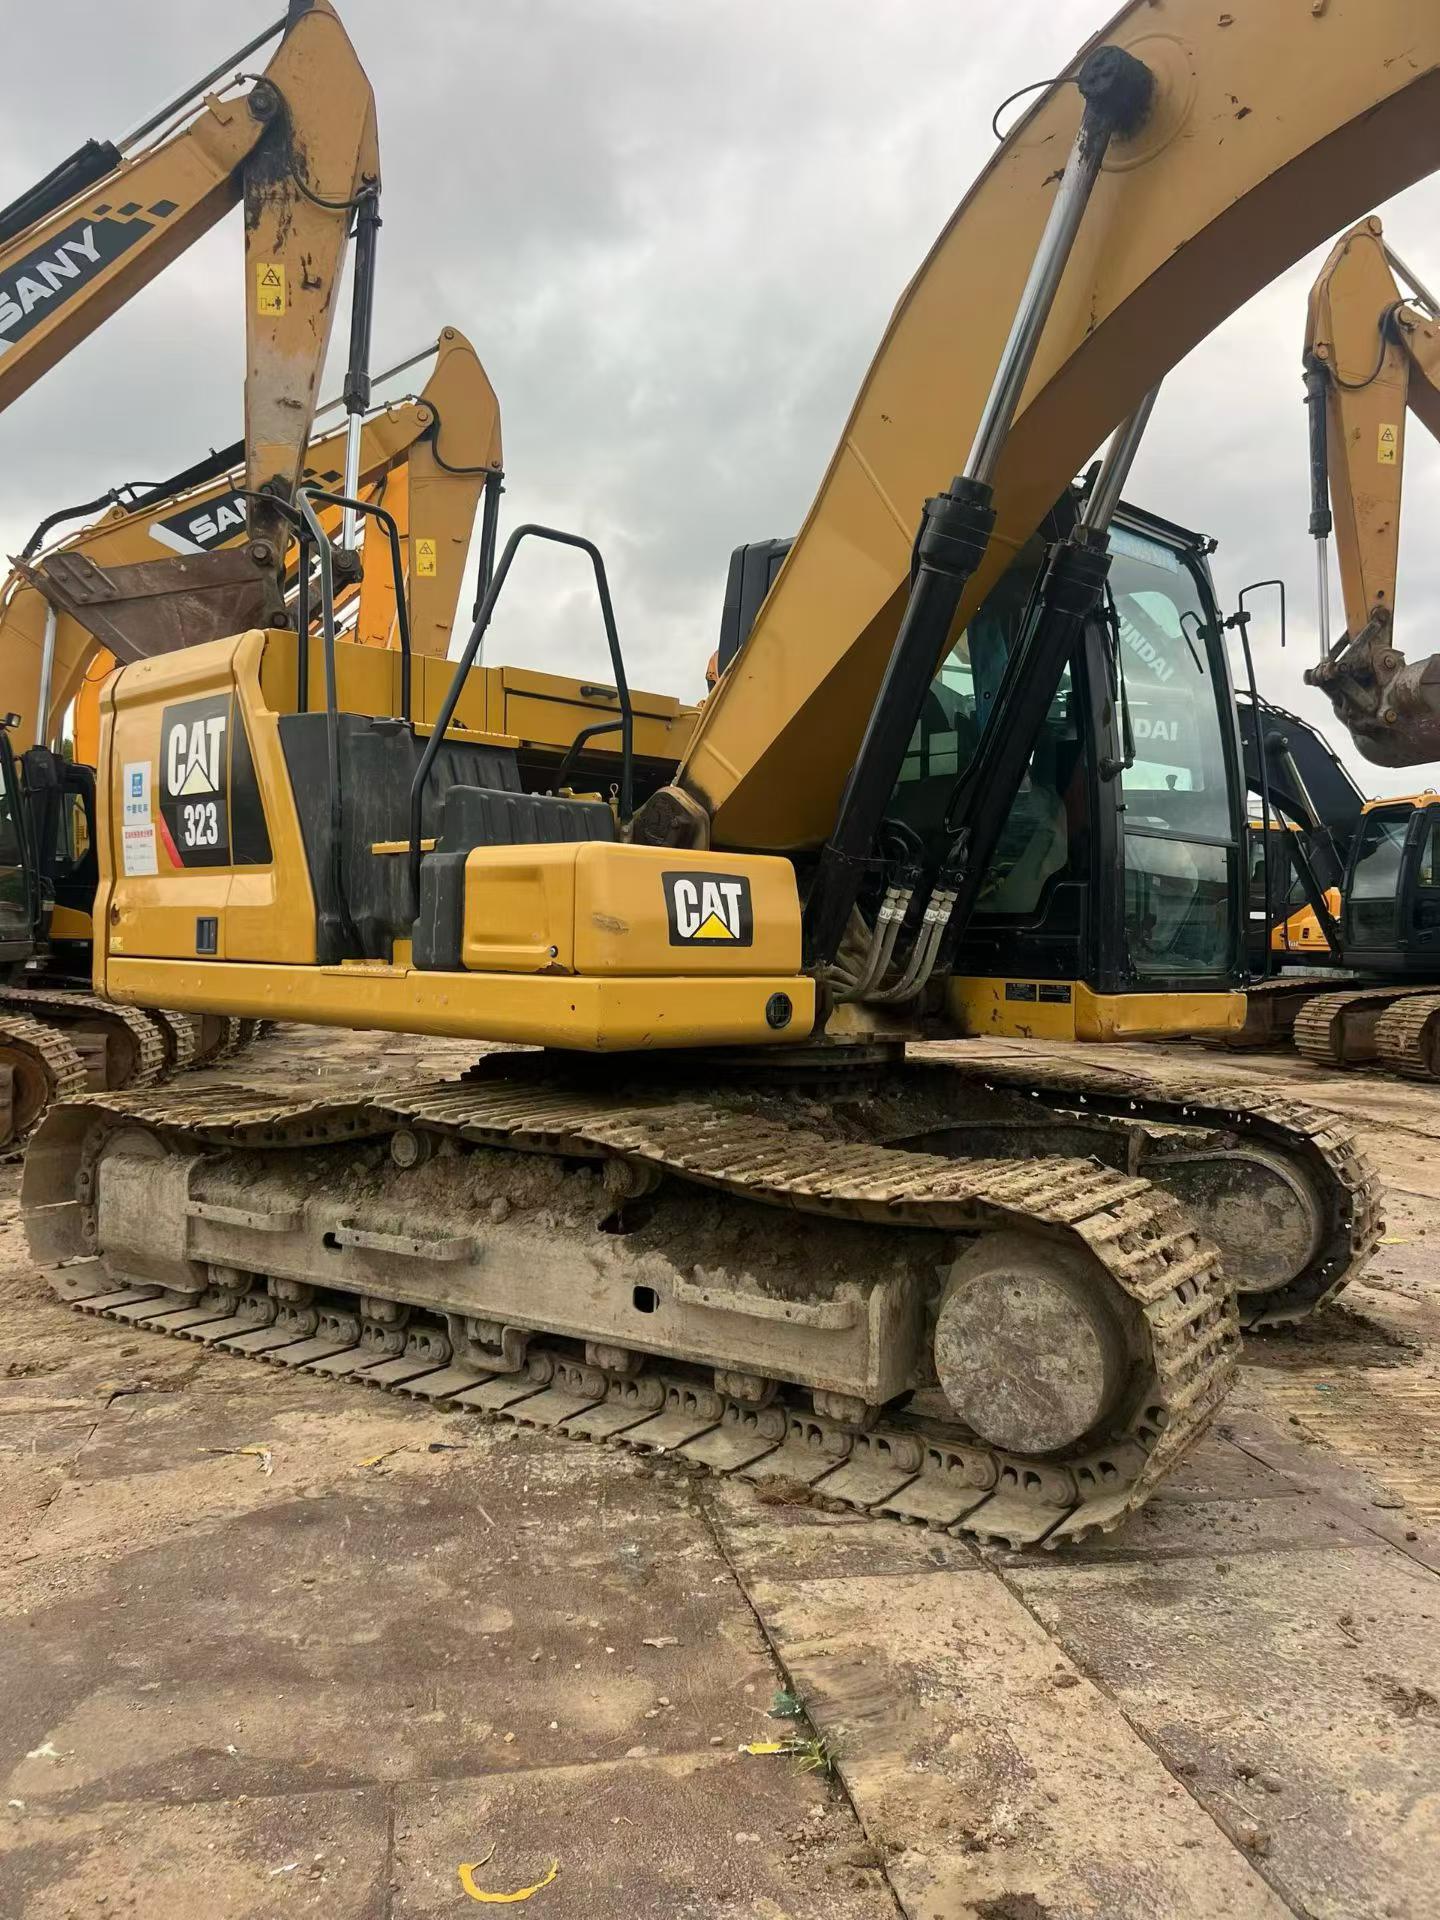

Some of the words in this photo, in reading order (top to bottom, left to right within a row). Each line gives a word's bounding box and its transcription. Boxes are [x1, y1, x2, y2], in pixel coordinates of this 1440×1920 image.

[0, 225, 101, 334] SANY
[167, 716, 226, 796] CAT
[183, 802, 218, 847] 323
[673, 879, 742, 939] CAT
